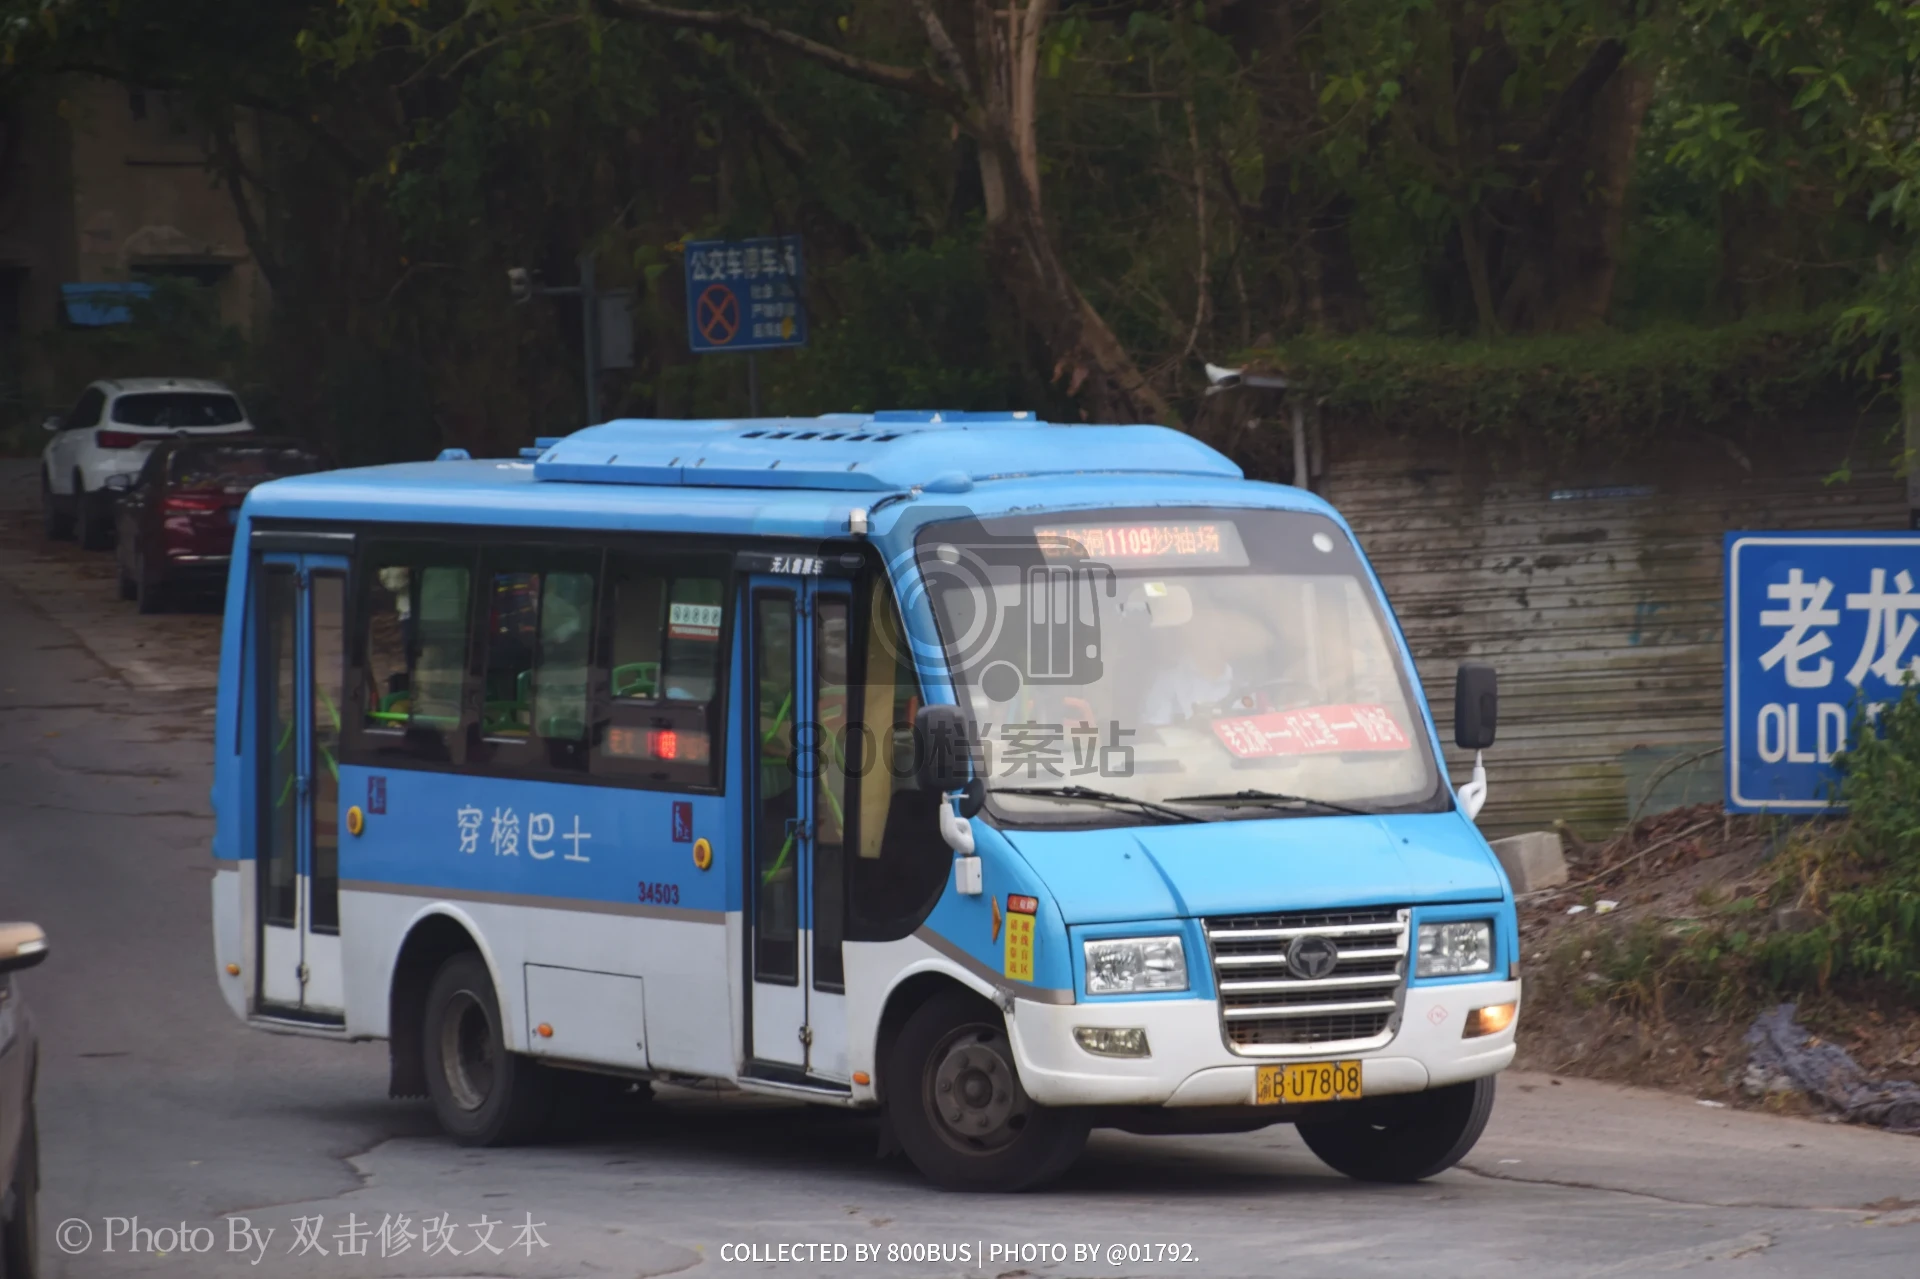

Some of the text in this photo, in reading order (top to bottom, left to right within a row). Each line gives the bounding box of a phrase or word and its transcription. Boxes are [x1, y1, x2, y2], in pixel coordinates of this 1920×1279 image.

[1758, 702, 1847, 763] OLD
[457, 804, 592, 863] 穿梭巴士
[638, 881, 680, 905] 34503
